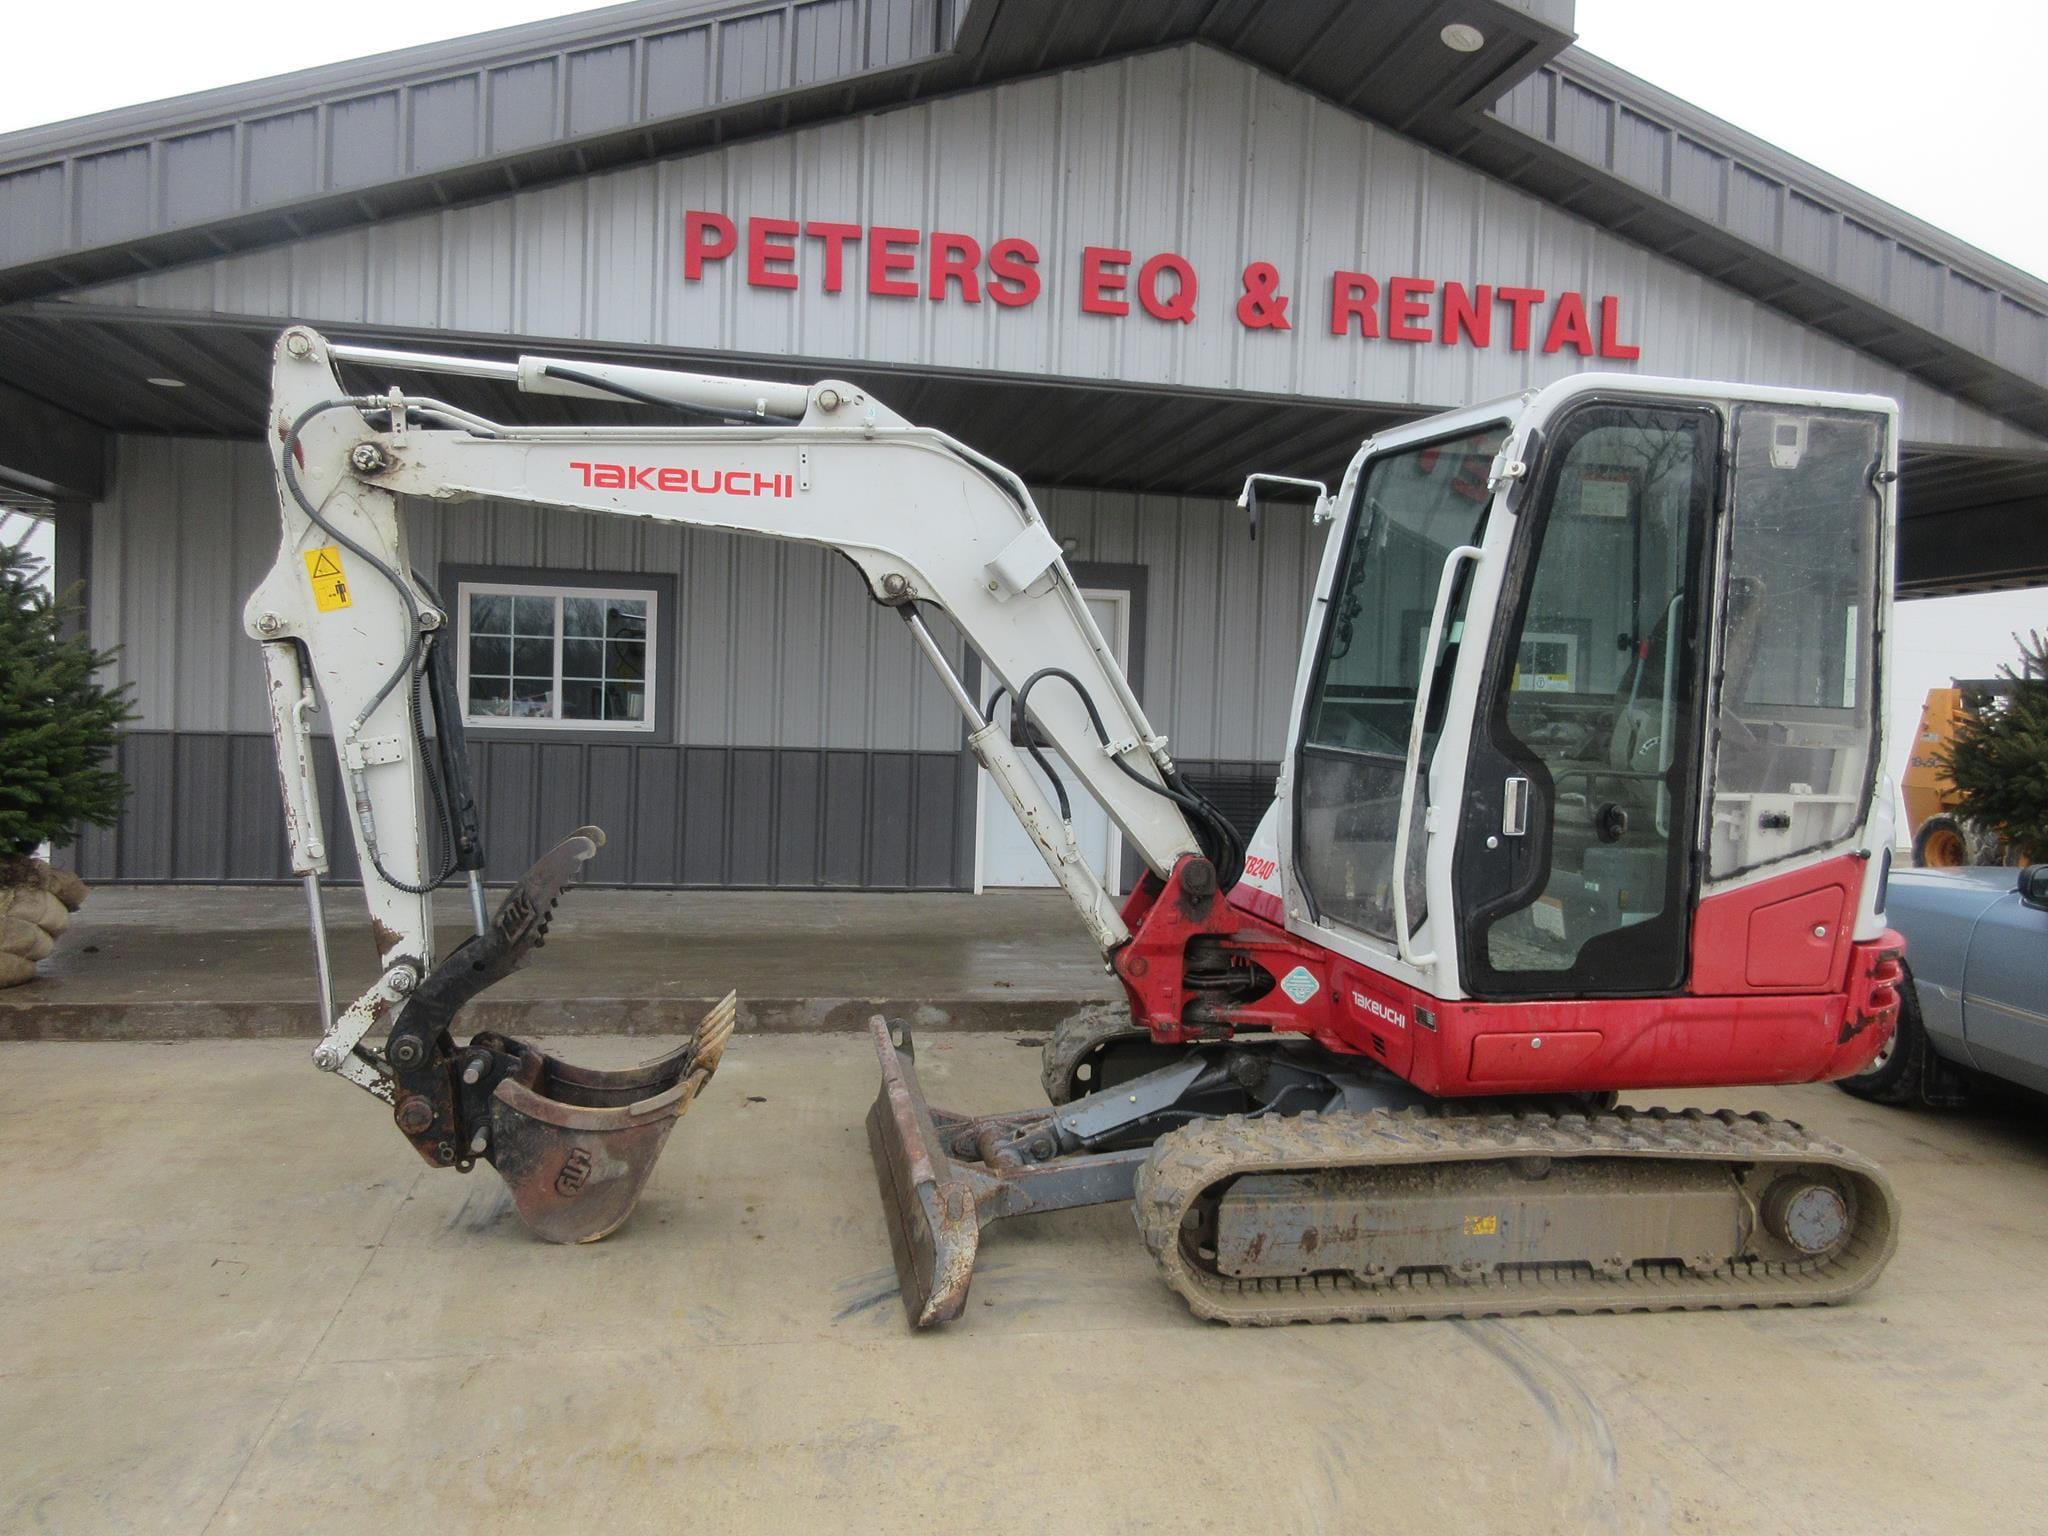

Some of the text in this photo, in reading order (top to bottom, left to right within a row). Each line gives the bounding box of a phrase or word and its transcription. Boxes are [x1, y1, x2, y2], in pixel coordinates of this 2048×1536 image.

[684, 211, 1641, 360] PETERS EQ & RENTAL
[1245, 855, 1276, 881] TB240
